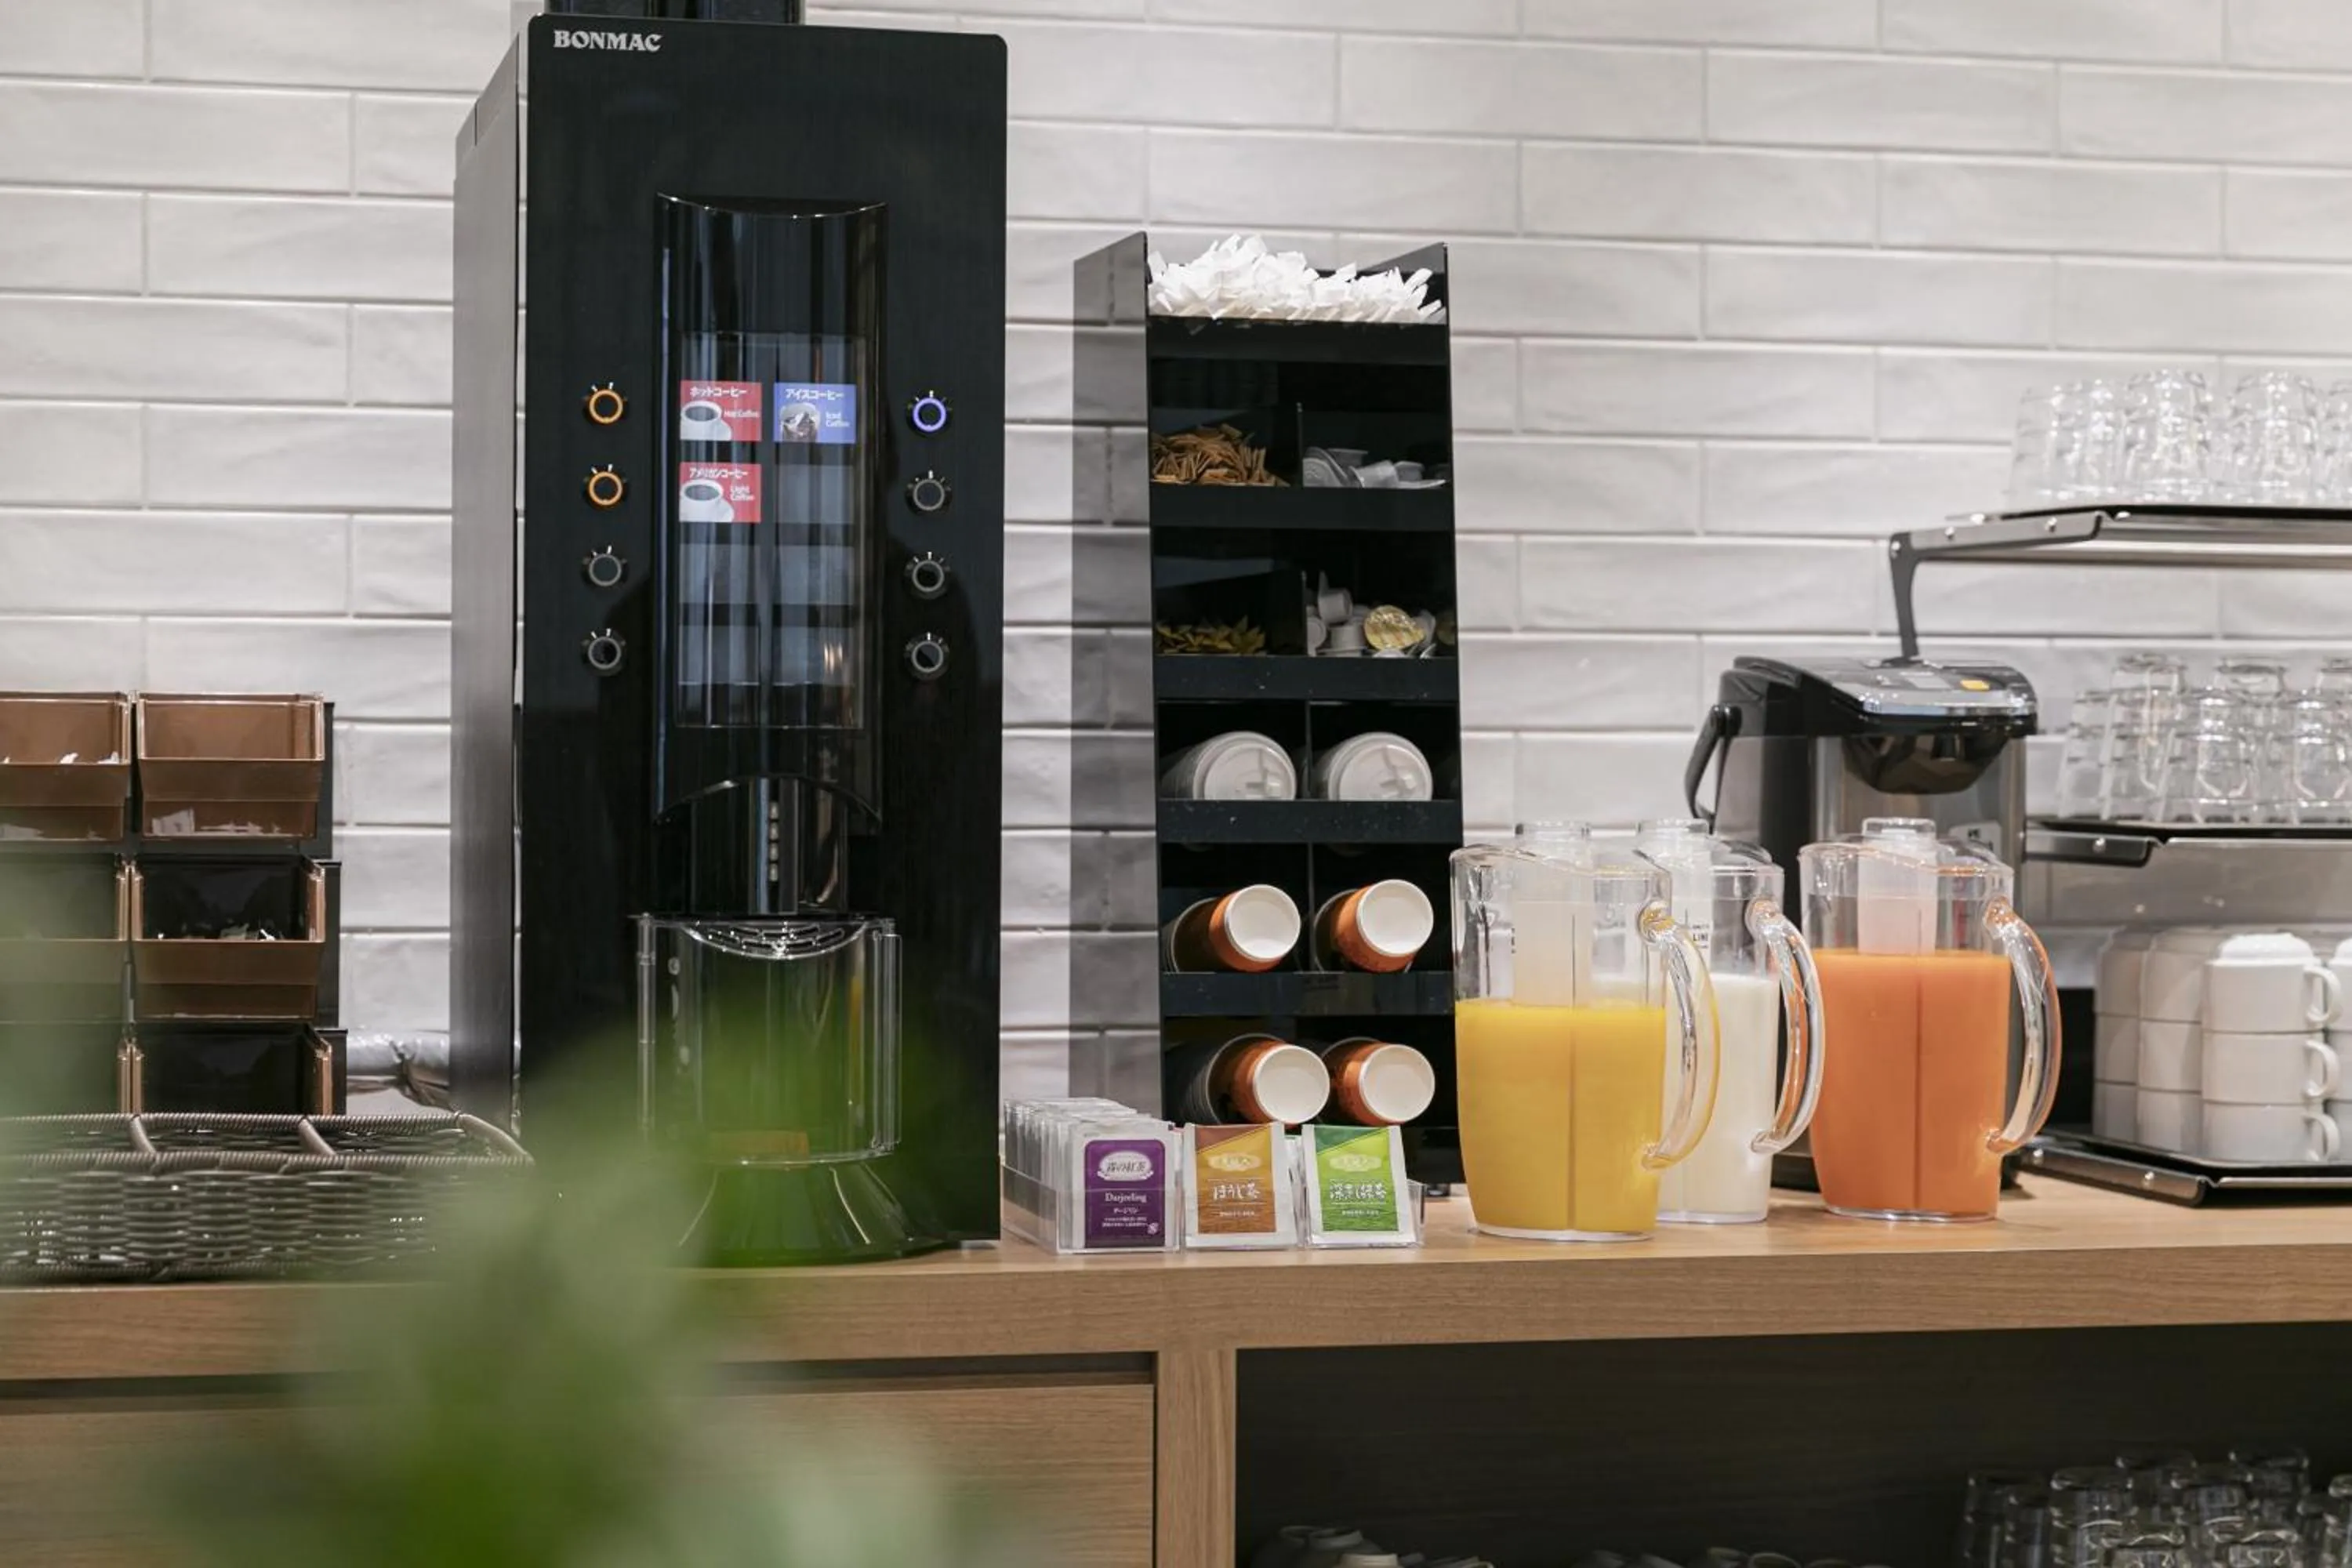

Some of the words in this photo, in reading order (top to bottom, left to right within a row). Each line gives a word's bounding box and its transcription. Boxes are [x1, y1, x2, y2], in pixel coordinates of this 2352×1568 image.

[554, 30, 662, 52] BONMAC
[690, 386, 747, 397] ホットコーヒー
[785, 388, 844, 401] アイスコーヒー
[690, 467, 749, 480] アメリカンコーヒー
[1212, 1181, 1261, 1200] ほうじ茶
[1105, 1192, 1147, 1203] Darjeeling
